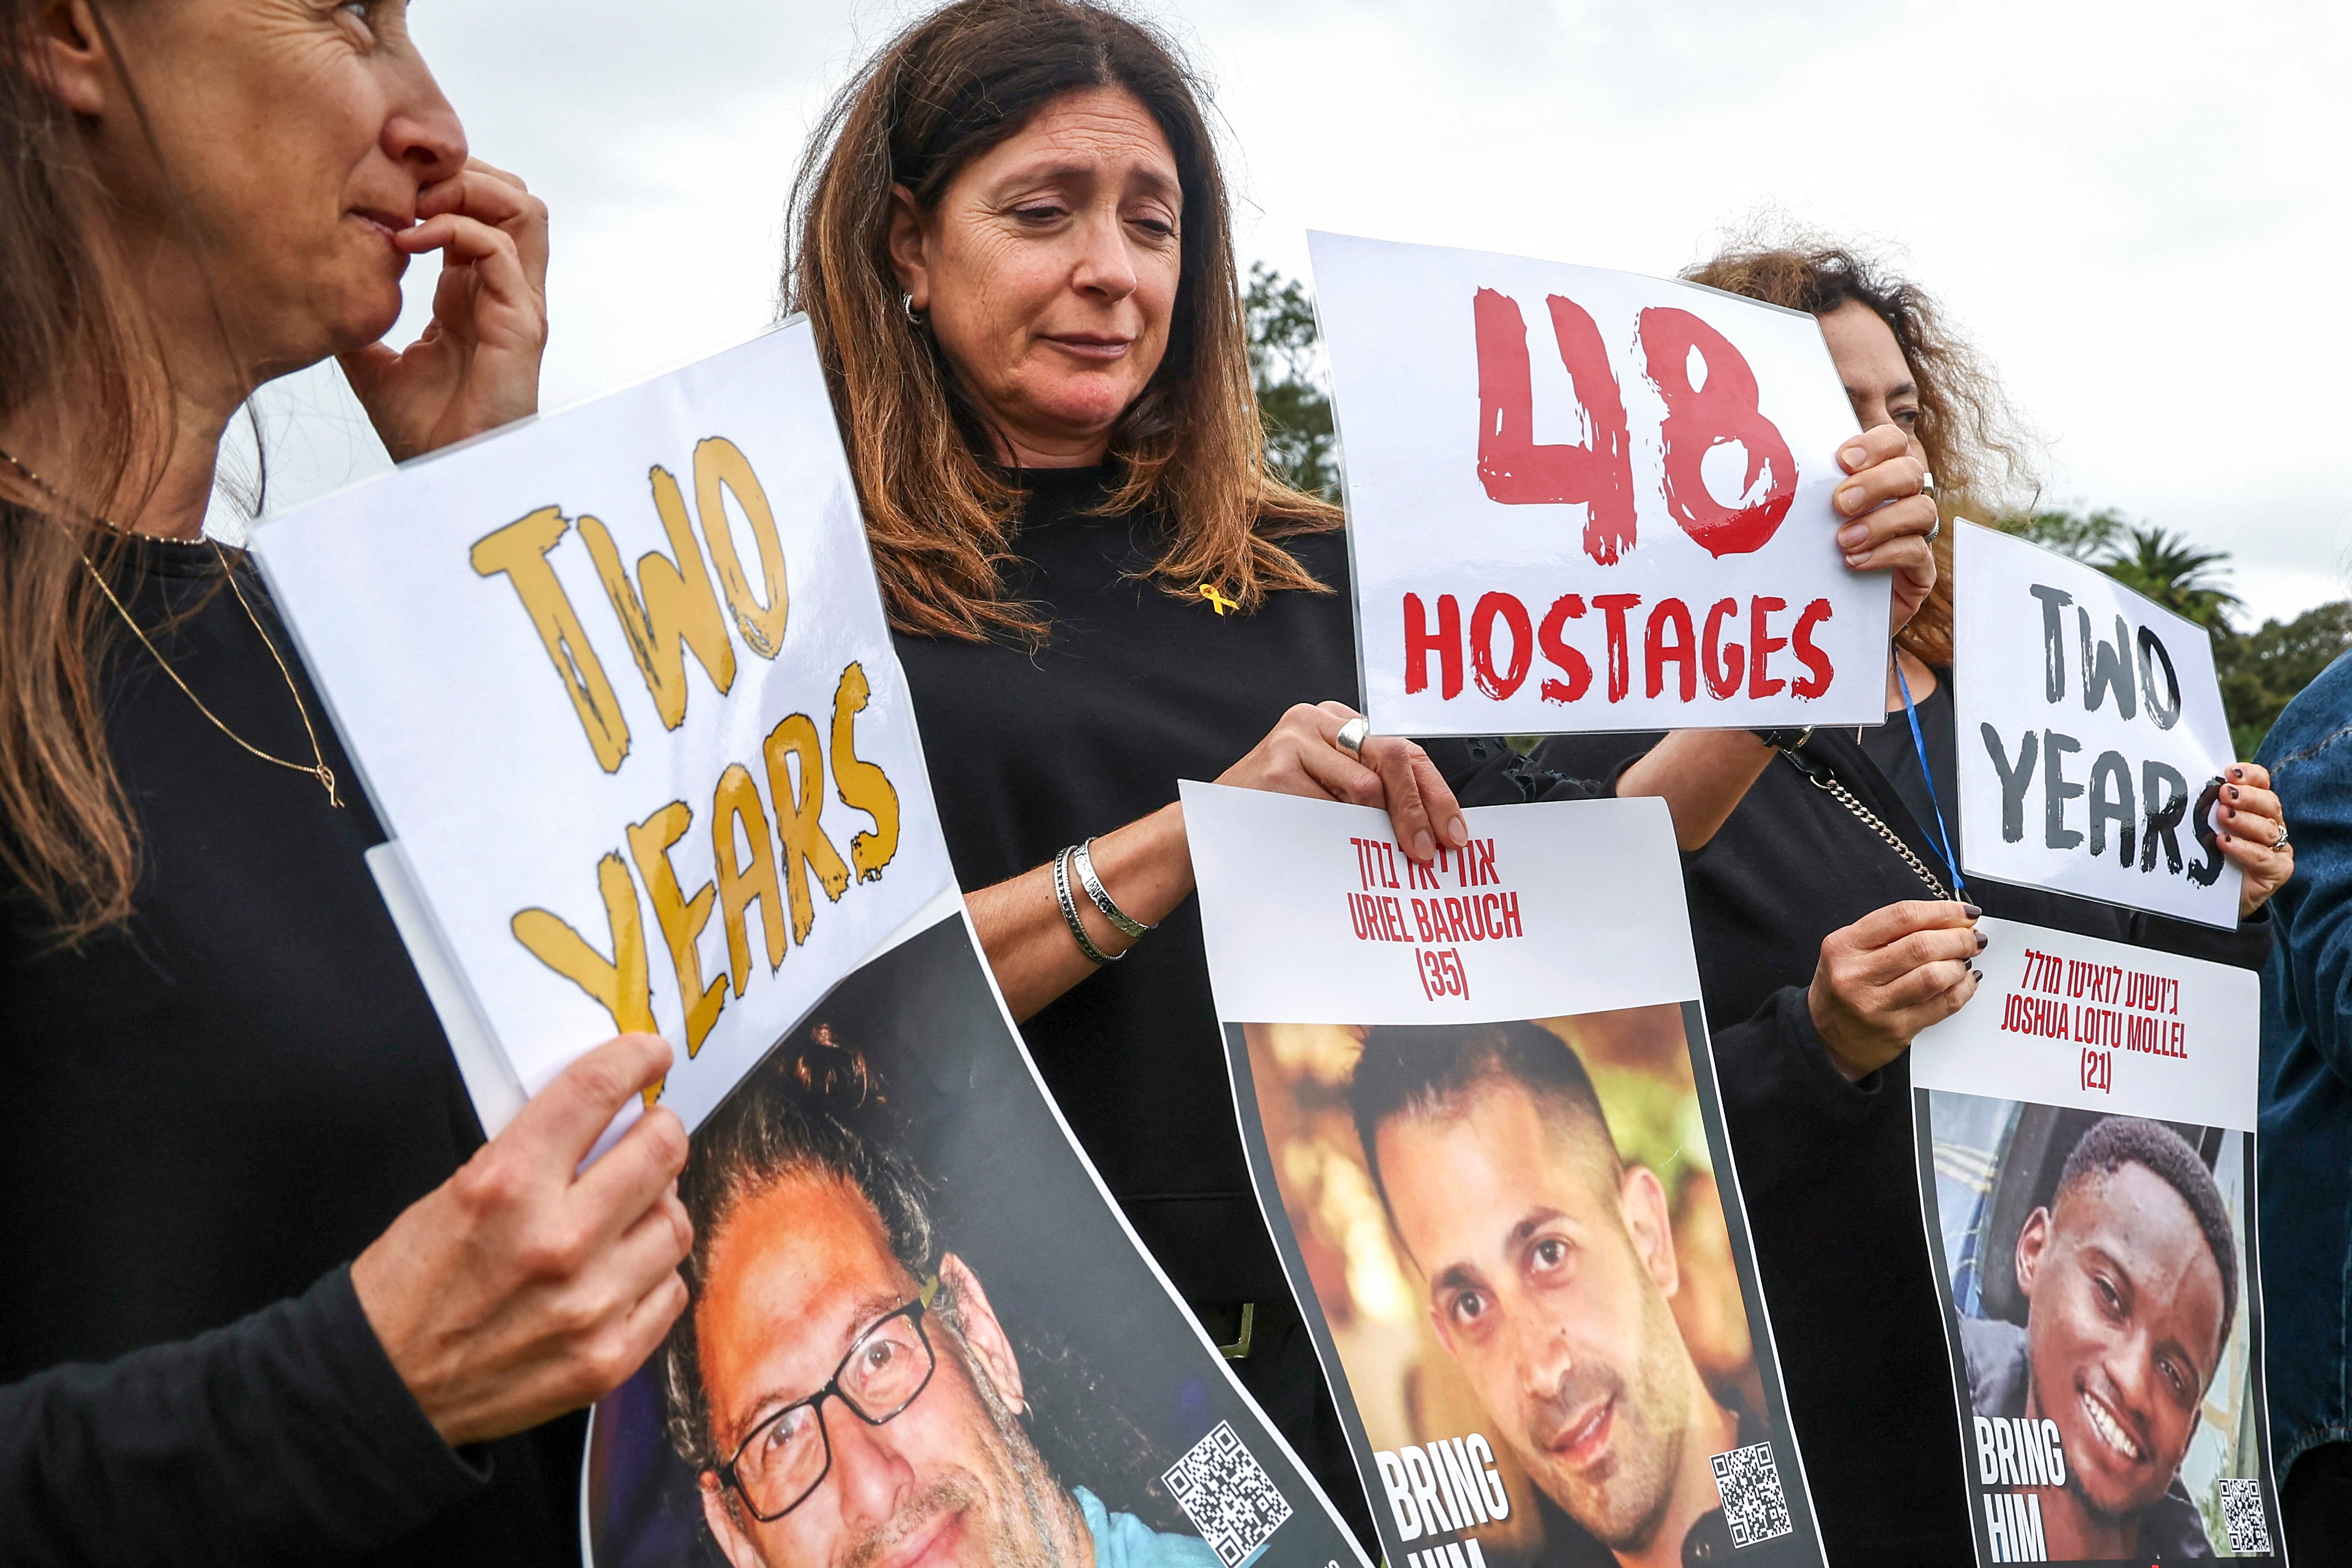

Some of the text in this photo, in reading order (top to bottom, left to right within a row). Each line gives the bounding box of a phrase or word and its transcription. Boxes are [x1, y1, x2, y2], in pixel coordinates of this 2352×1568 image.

[1474, 286, 1799, 565] 48
[470, 436, 789, 773] TWO
[1403, 591, 1834, 706] HOSTAGES
[2030, 583, 2181, 730] TWO
[1980, 722, 2228, 888] YEARS
[511, 661, 899, 1110] YEARS
[1350, 837, 1401, 891] ברוך
[1347, 891, 1523, 942] URIEL BARUCH
[1415, 948, 1469, 1001] (35)
[2021, 949, 2063, 995] מולל
[2067, 960, 2123, 1004] לואיטו
[2001, 994, 2188, 1058] JOSHUA LOITU MOLLEL
[2080, 1048, 2112, 1094] (21)
[1973, 1416, 2066, 1486] BRING
[1374, 1433, 1510, 1542] BRING
[1983, 1494, 2047, 1563] HIM
